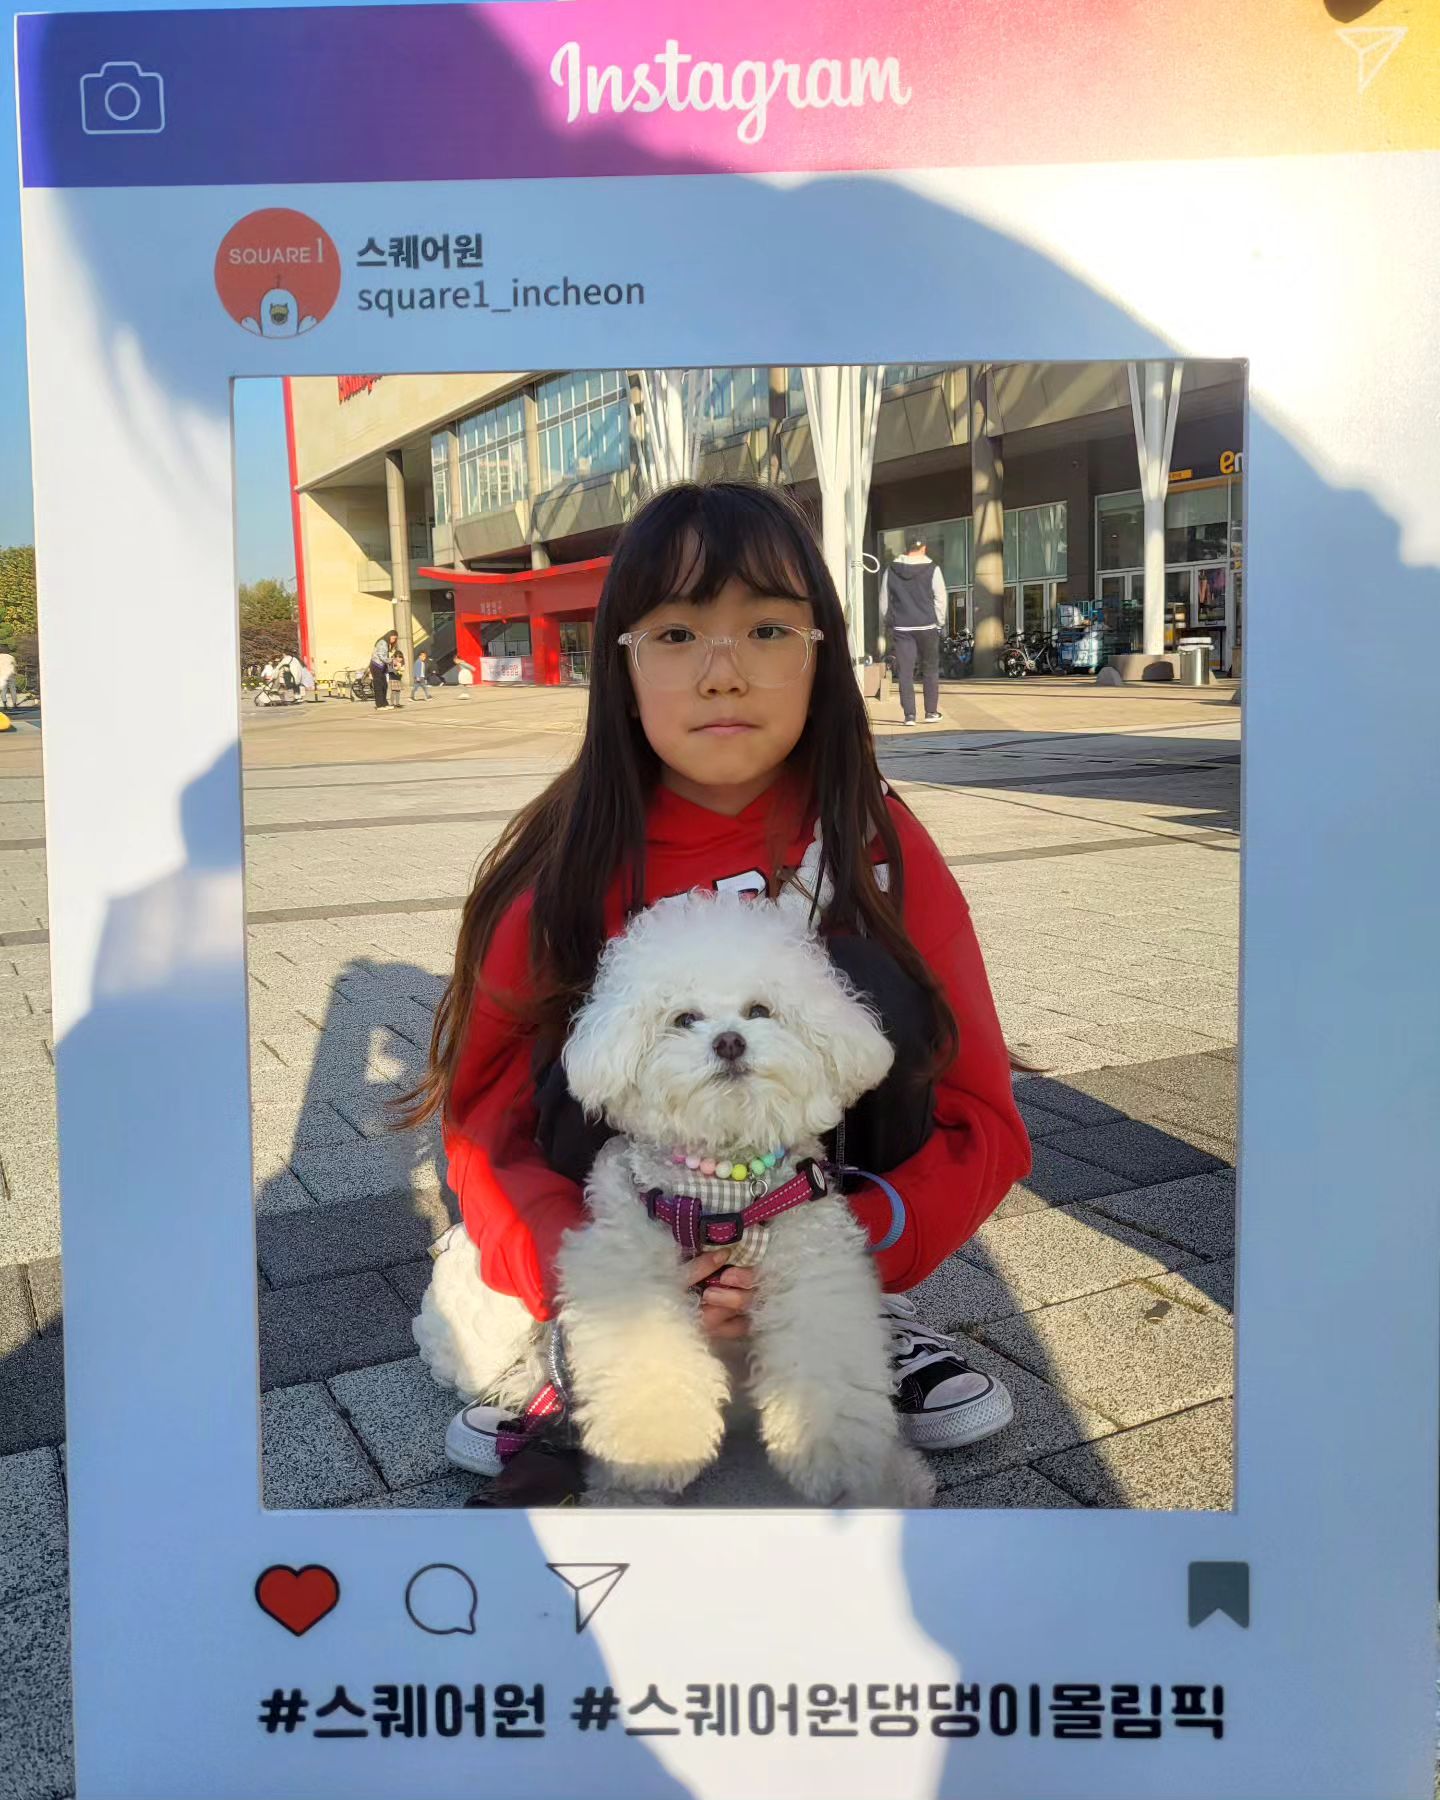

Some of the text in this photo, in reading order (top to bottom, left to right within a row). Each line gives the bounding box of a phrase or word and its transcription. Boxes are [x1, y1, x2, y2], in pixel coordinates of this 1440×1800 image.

[550, 39, 912, 144] Instagram
[356, 233, 483, 269] 스퀘어원
[356, 276, 646, 318] square1_incheon
[258, 1682, 1224, 1740] #스퀘어원 #스퀘어원댕댕이몰림픽
